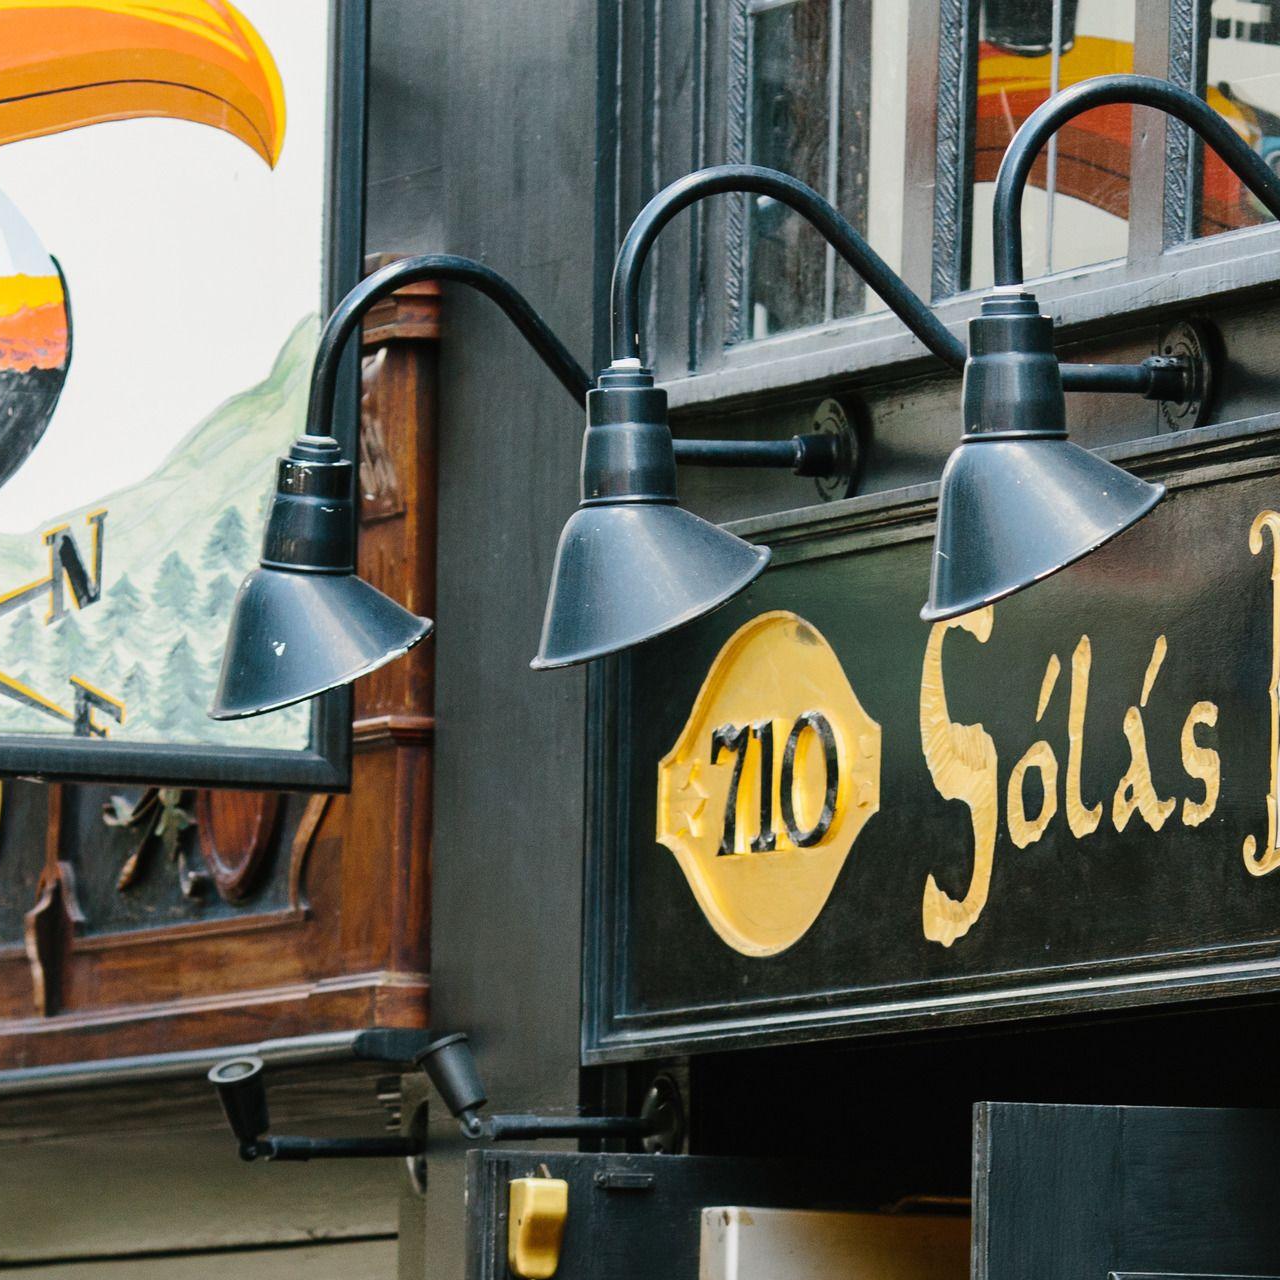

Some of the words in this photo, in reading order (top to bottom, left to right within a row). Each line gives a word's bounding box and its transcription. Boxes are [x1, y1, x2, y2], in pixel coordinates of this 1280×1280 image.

[42, 510, 109, 626] N
[710, 710, 840, 857] 710
[920, 604, 1221, 947] Sólás
